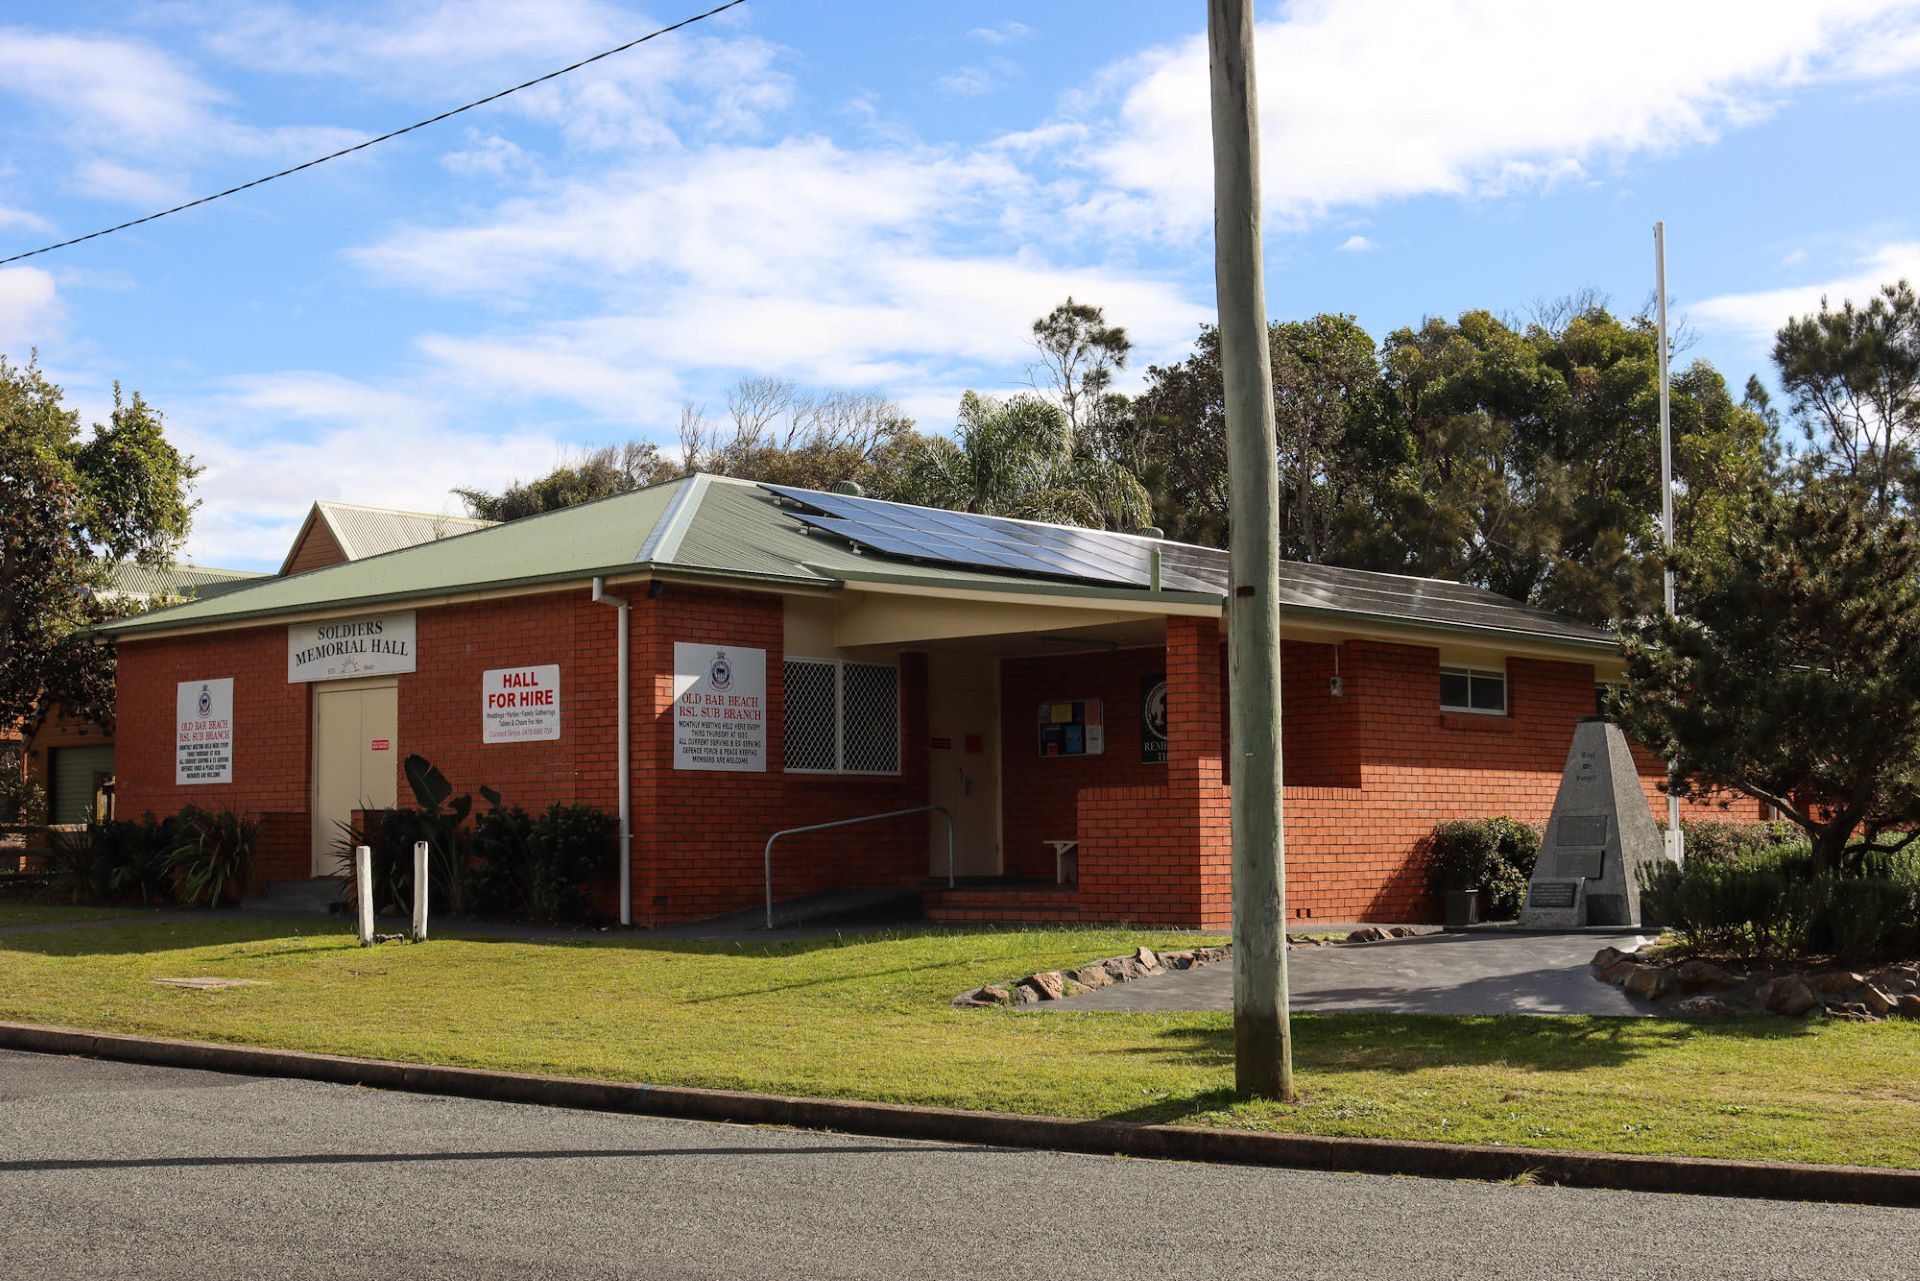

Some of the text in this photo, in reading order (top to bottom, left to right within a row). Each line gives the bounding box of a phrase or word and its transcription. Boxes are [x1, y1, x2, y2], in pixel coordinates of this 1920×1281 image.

[318, 621, 383, 640] SOLDIERS
[296, 639, 408, 667] MEMORIAL HALL
[504, 672, 538, 688] HALL
[489, 690, 553, 708] FOR HIRE
[682, 692, 758, 707] OLD BAR BEACH
[680, 706, 761, 720] RSL SUB BRANCH
[182, 720, 228, 731] OLD BAR BEACH
[180, 730, 229, 742] RSL SUB BRANCH
